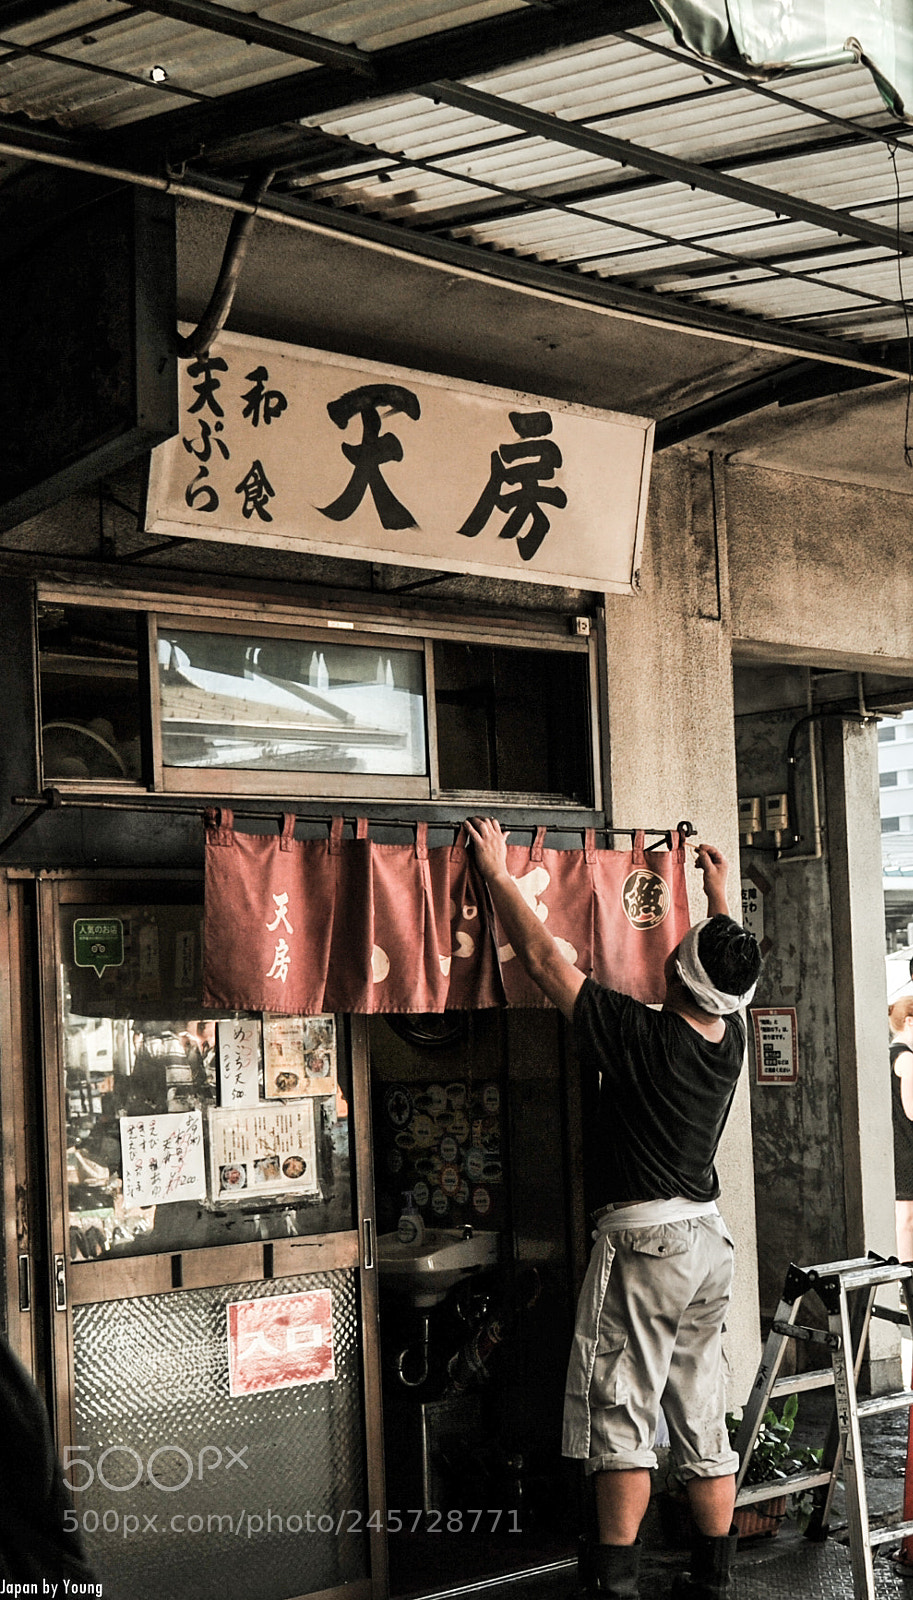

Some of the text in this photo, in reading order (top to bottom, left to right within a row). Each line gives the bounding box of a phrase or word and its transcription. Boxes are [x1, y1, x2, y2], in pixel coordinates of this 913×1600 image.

[183, 356, 230, 513] 天ぷら
[234, 366, 288, 523] 和食
[314, 384, 568, 561] 天房
[266, 892, 294, 984] 天房
[237, 1323, 323, 1360] 入口
